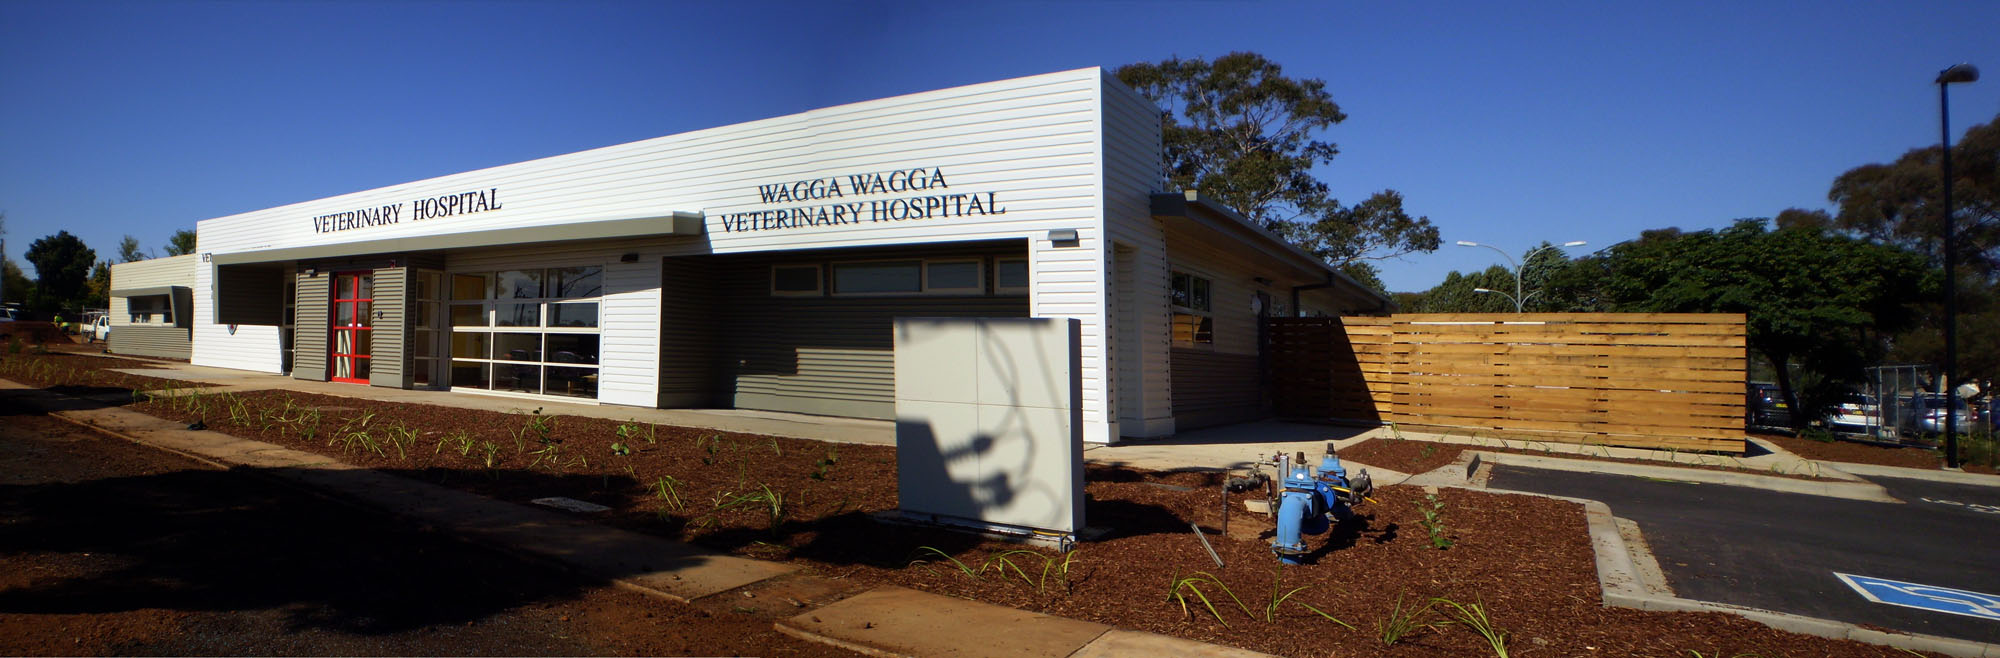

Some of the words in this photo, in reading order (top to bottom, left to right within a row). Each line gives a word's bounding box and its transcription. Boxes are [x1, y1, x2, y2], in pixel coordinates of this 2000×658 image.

[759, 177, 843, 203] WAGGA
[849, 166, 947, 195] WAGGA
[313, 203, 402, 233] VETERINARY
[413, 188, 502, 220] HOSPITAL
[721, 203, 865, 232] VETERINARY
[870, 192, 1006, 222] HOSPITAL
